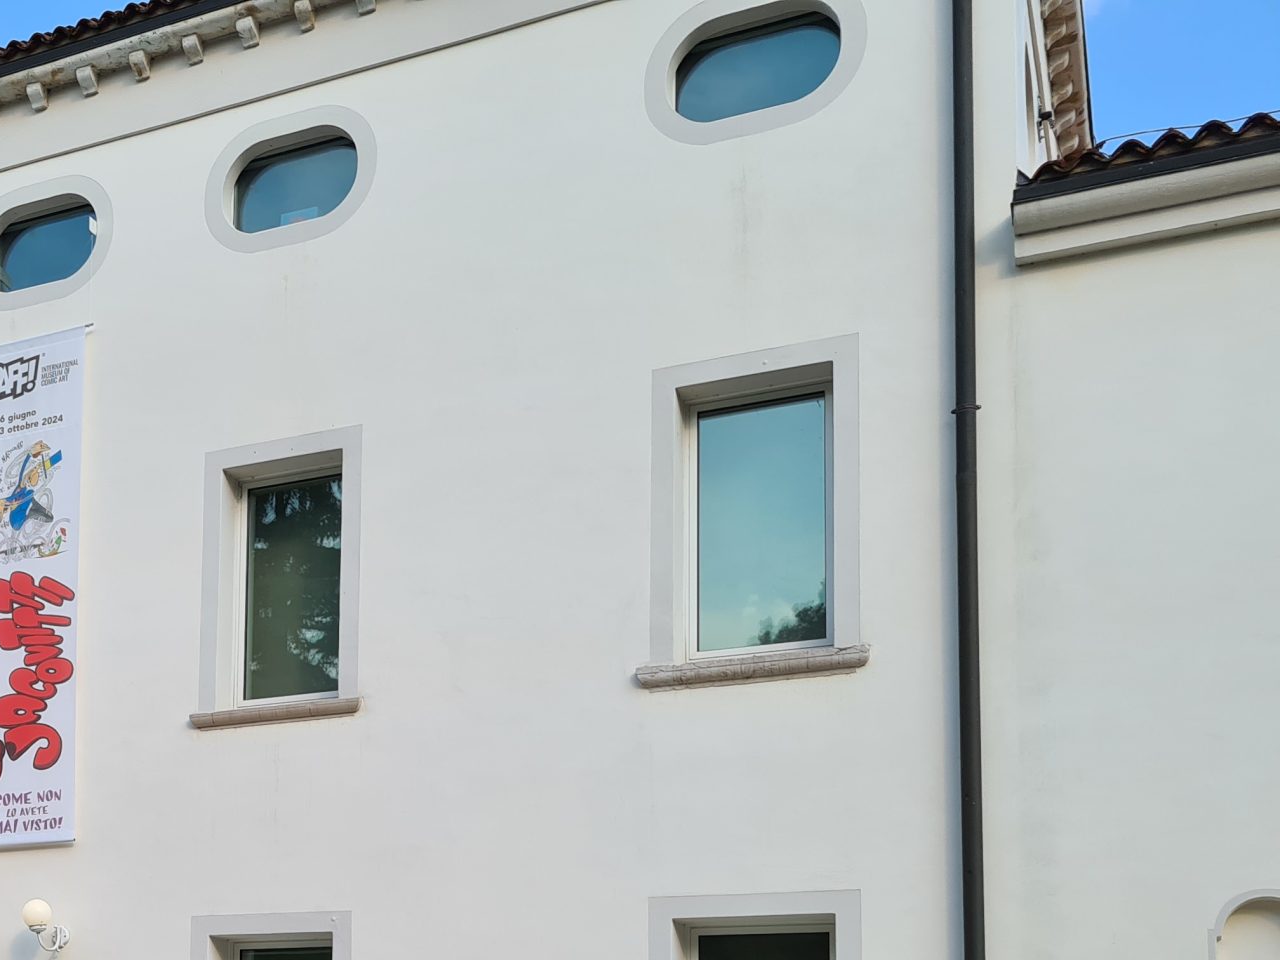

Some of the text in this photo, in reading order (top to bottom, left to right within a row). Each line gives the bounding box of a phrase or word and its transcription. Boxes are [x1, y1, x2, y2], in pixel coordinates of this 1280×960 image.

[58, 375, 69, 383] ART
[0, 414, 6, 424] 6
[7, 410, 37, 424] giugno
[7, 421, 39, 434] ottobre
[41, 414, 64, 426] 2024
[36, 789, 62, 803] NON
[6, 805, 49, 818] LO AVETE
[22, 816, 63, 832] VISTO!
